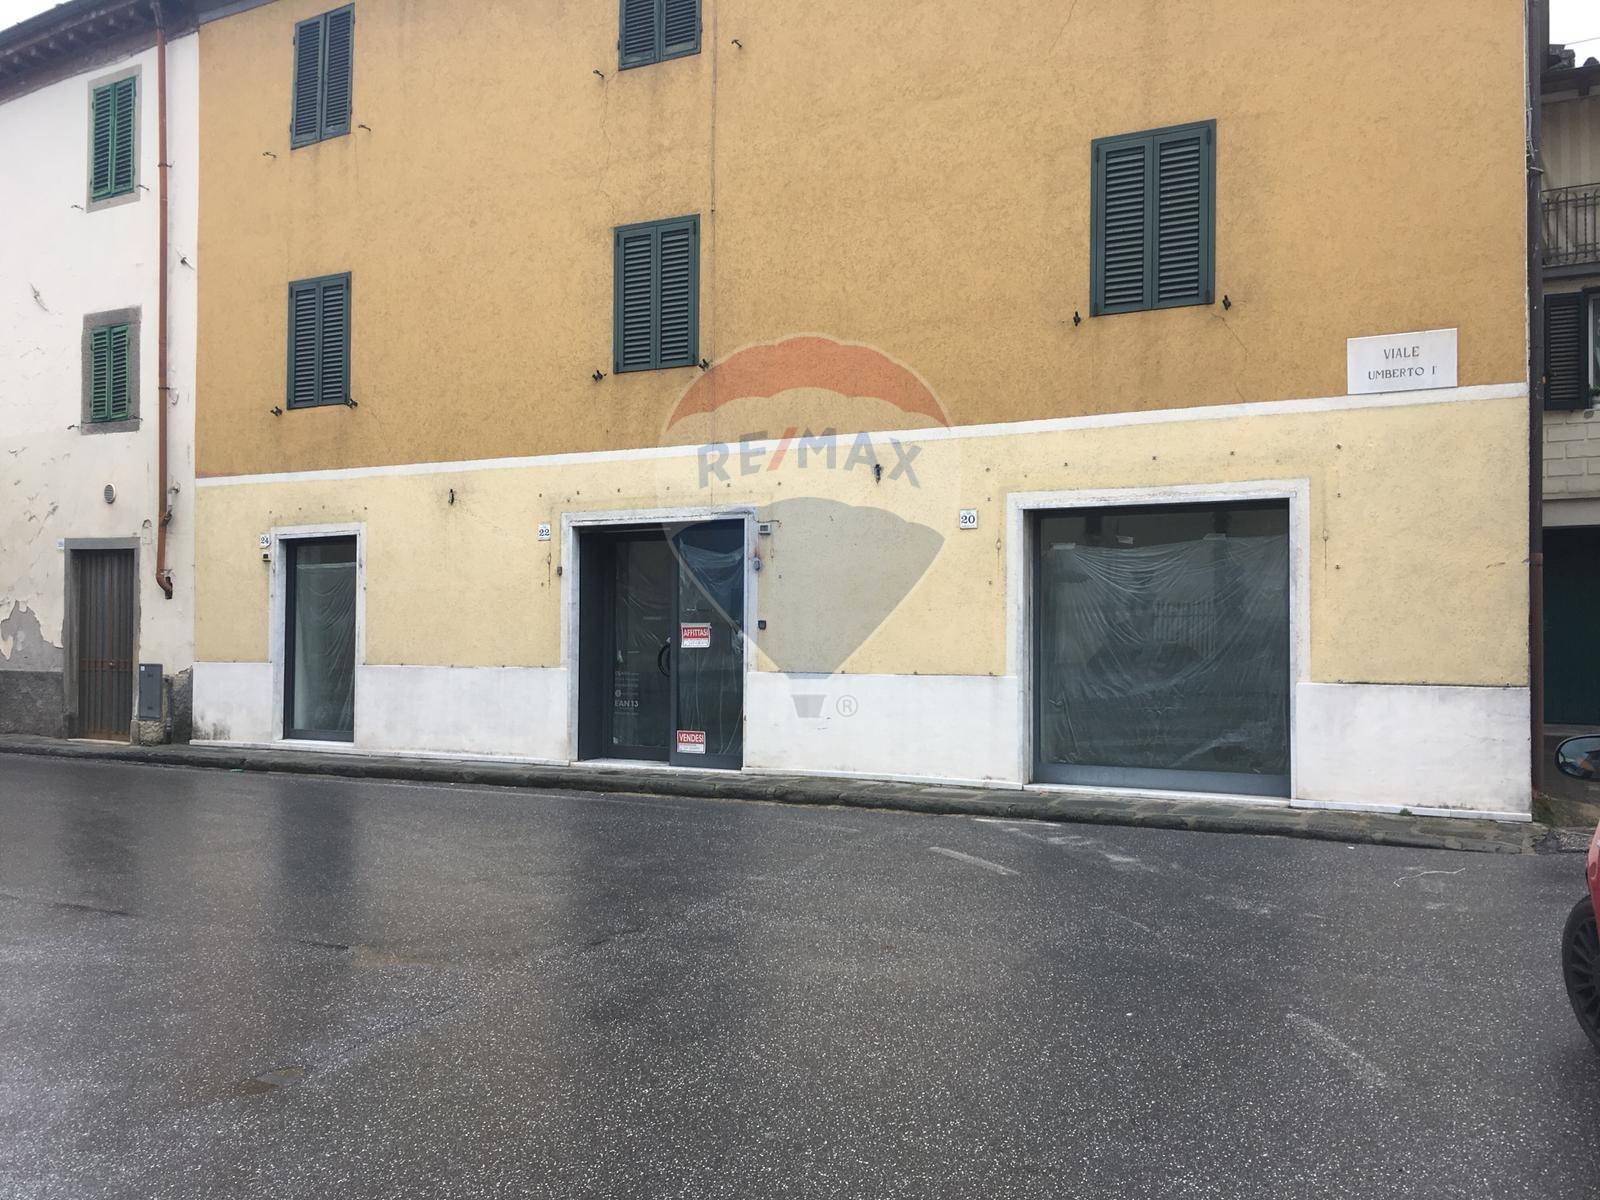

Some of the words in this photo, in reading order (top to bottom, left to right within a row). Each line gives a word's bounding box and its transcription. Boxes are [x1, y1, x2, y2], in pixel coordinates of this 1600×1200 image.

[1383, 346, 1420, 360] VIALE
[1368, 366, 1425, 381] UMBERTO
[960, 515, 976, 525] 20
[538, 528, 550, 537] 22
[260, 535, 269, 545] 24
